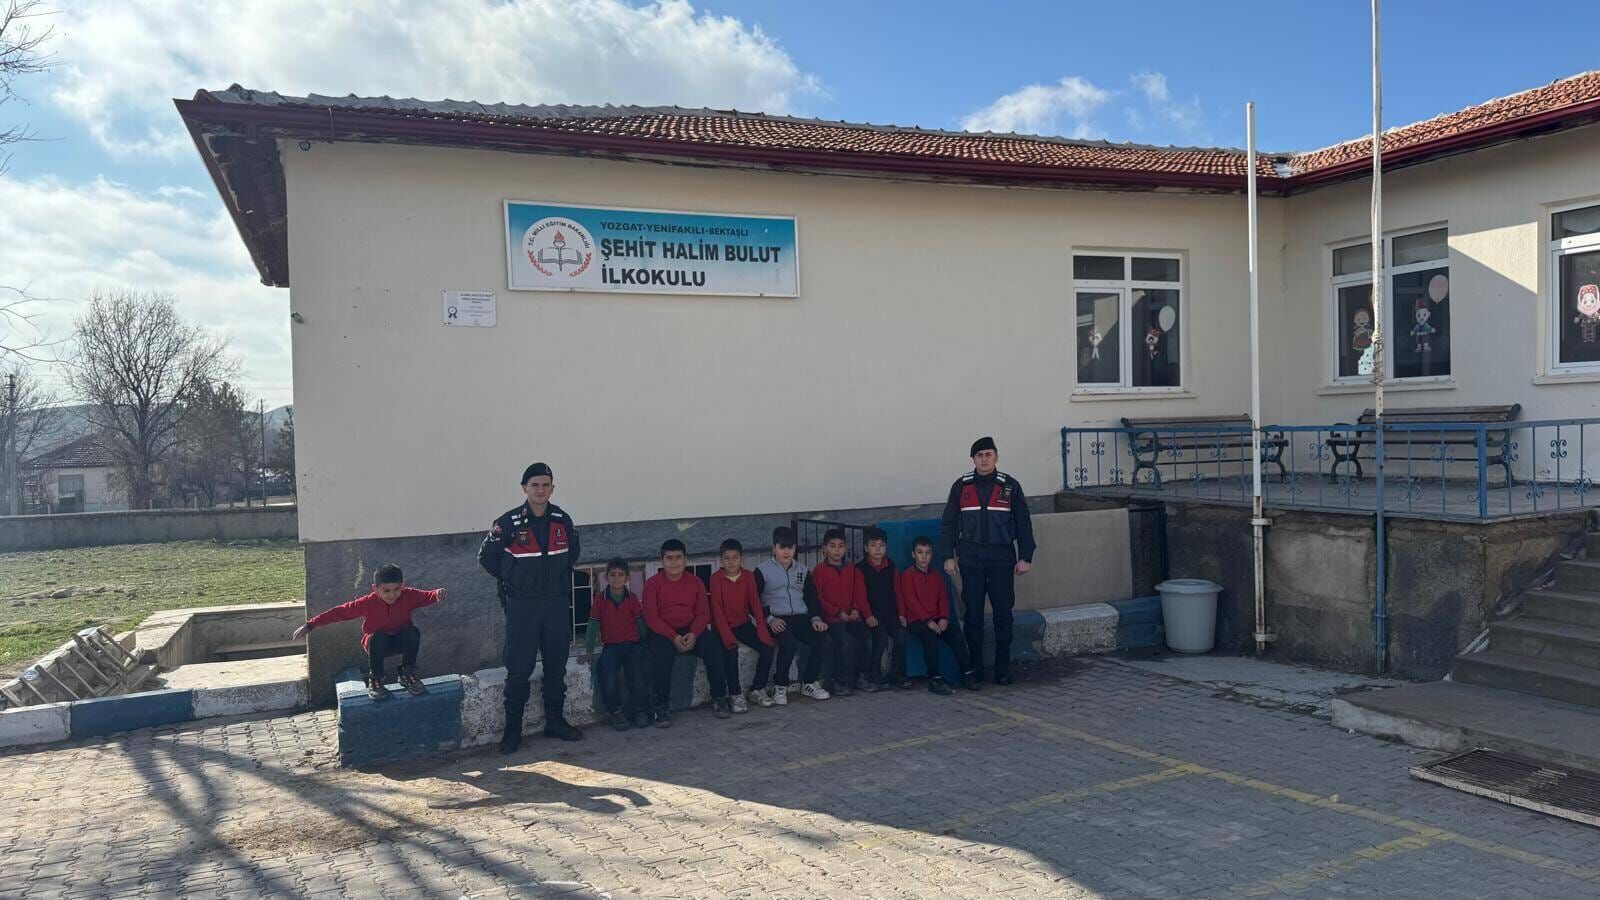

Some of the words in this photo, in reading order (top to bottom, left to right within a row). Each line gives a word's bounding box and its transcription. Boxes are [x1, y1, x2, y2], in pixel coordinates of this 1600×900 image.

[600, 222, 748, 236] YOZGAT-YENİFAKILI-BEKTAŞLI
[601, 236, 656, 260] ŞEHİT
[662, 239, 719, 261] HALİM
[724, 244, 782, 263] BULUT
[601, 263, 706, 287] İLKOKULU
